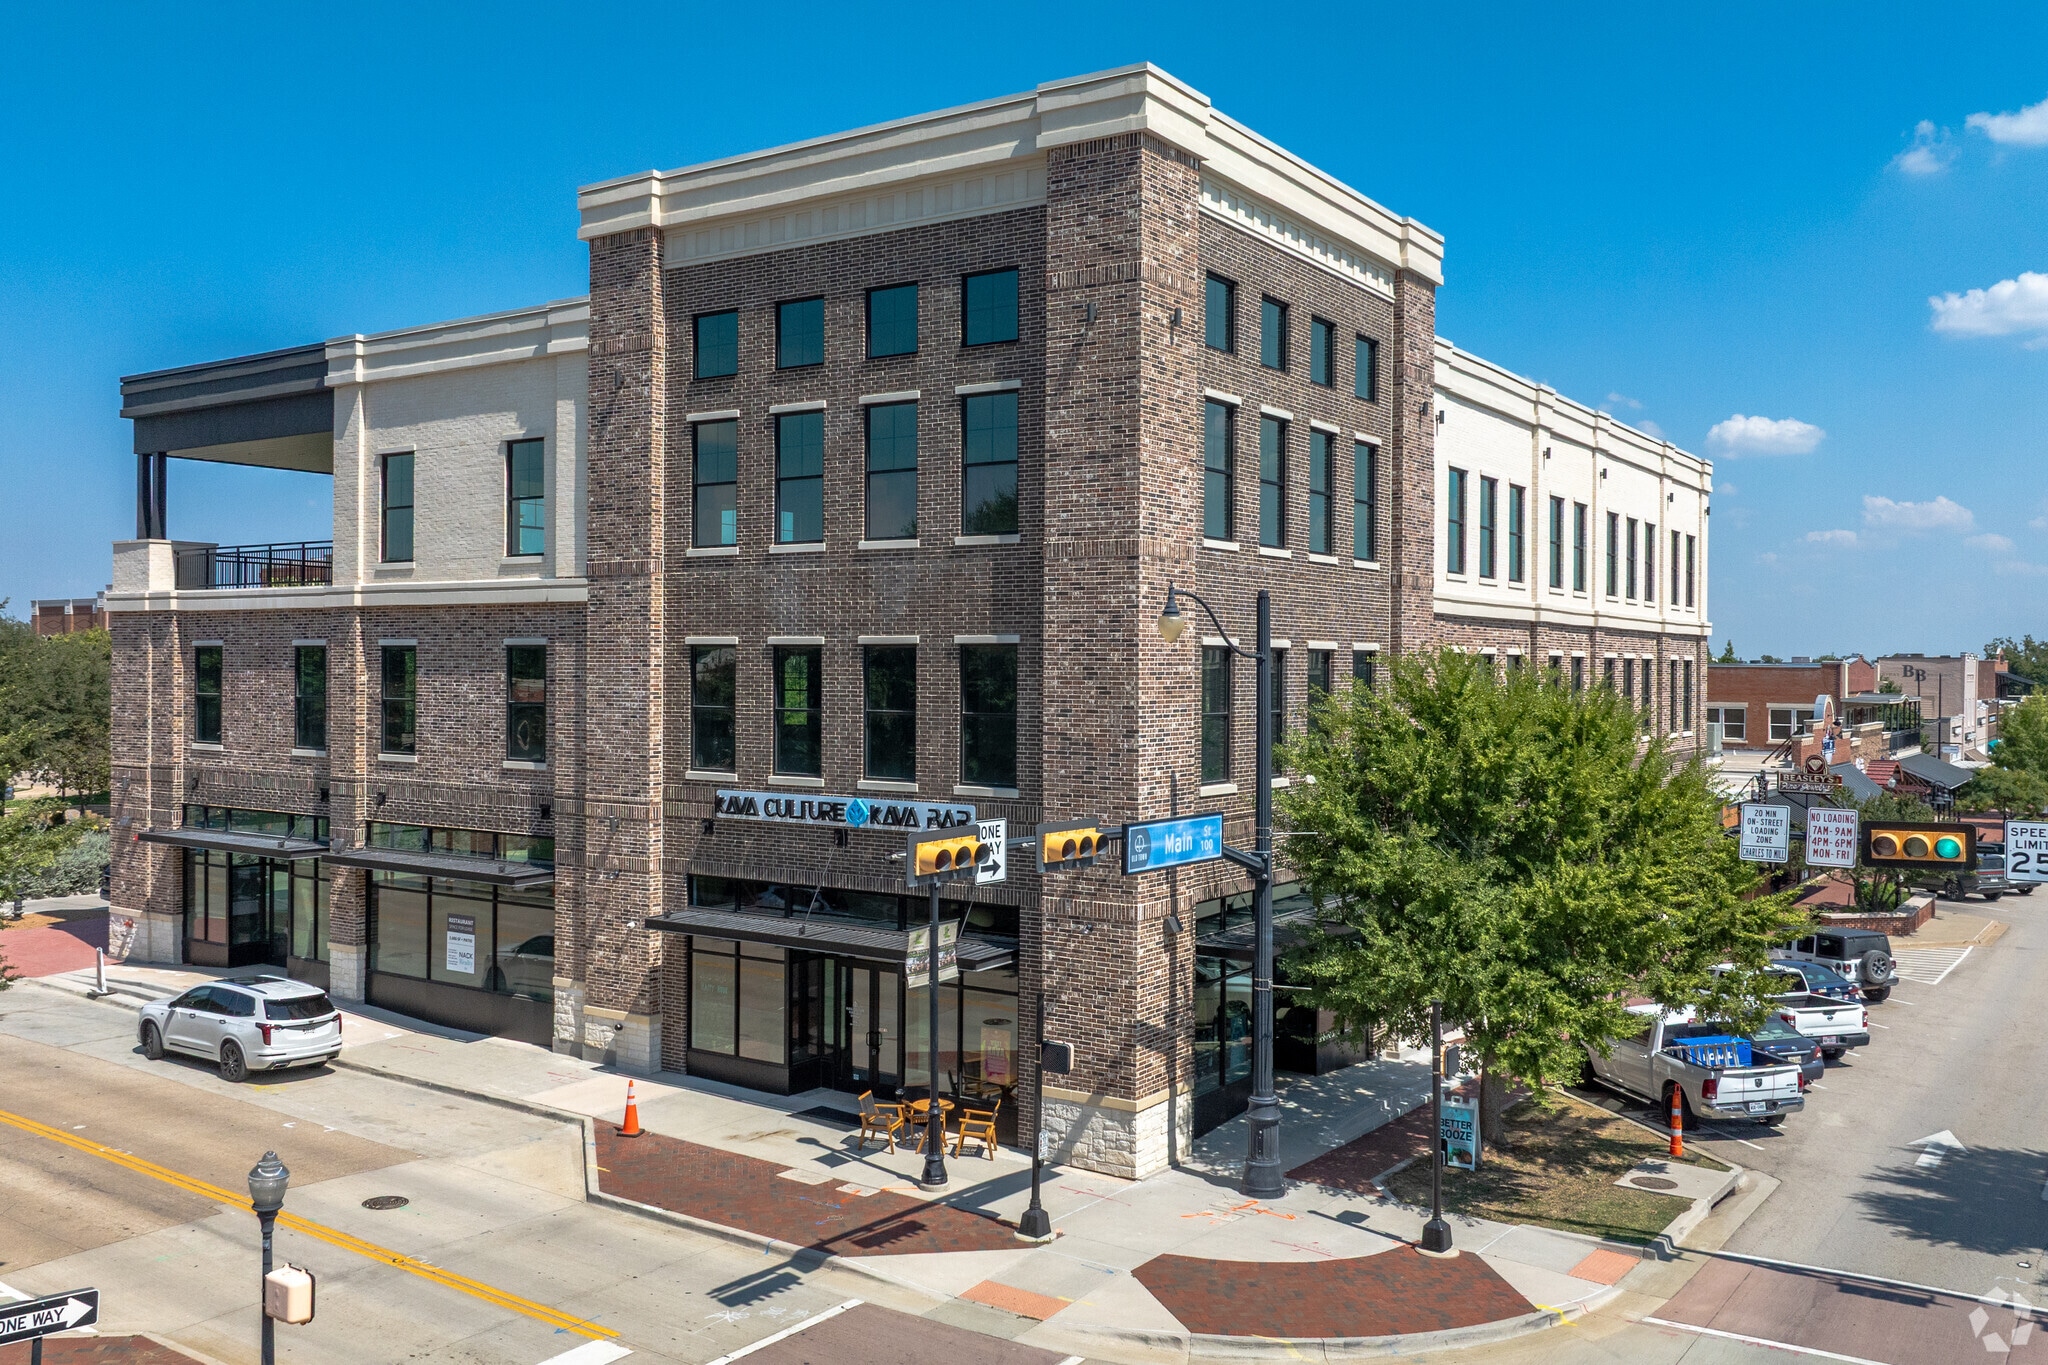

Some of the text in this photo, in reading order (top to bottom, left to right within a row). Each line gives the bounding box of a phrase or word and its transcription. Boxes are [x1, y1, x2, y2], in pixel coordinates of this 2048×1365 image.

[715, 795, 972, 828] KAVA CULTURE KAVA BAR
[1754, 809, 1763, 817] 20
[1811, 812, 1854, 824] NO LOADING
[981, 824, 1001, 840] ONE
[1204, 825, 1211, 836] St
[1751, 827, 1778, 835] LOADING
[989, 841, 1001, 855] AY
[1165, 832, 1193, 854] Main
[1201, 839, 1213, 851] 100
[2016, 840, 2048, 850] LIMIT
[1743, 847, 1784, 859] CHARLES TO MILL
[2011, 852, 2048, 875] 25
[1440, 1118, 1472, 1130] BETTER
[1440, 1128, 1472, 1141] BOOZE
[33, 1308, 65, 1326] WAY
